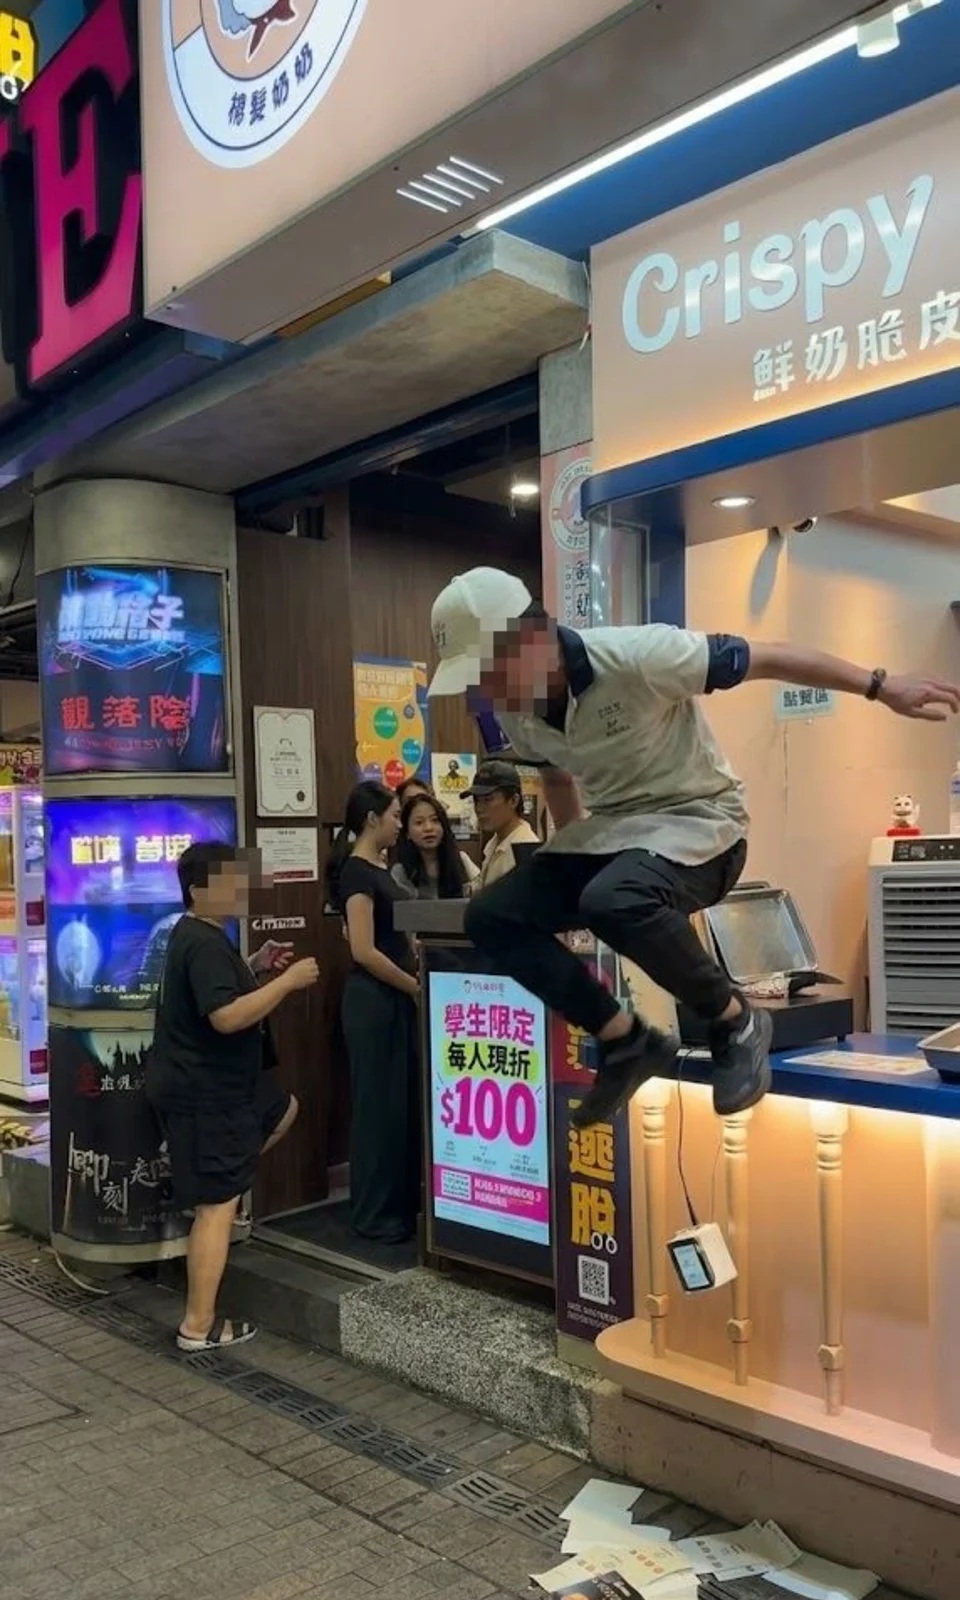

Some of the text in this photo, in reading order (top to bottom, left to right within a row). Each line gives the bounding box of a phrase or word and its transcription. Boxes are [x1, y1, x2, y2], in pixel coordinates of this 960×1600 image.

[622, 174, 935, 354] Crispy
[752, 290, 960, 402] 鮮奶脆皮
[444, 1002, 536, 1047] 學生限定
[447, 1041, 532, 1080] 每人現折
[440, 1075, 537, 1147] $100
